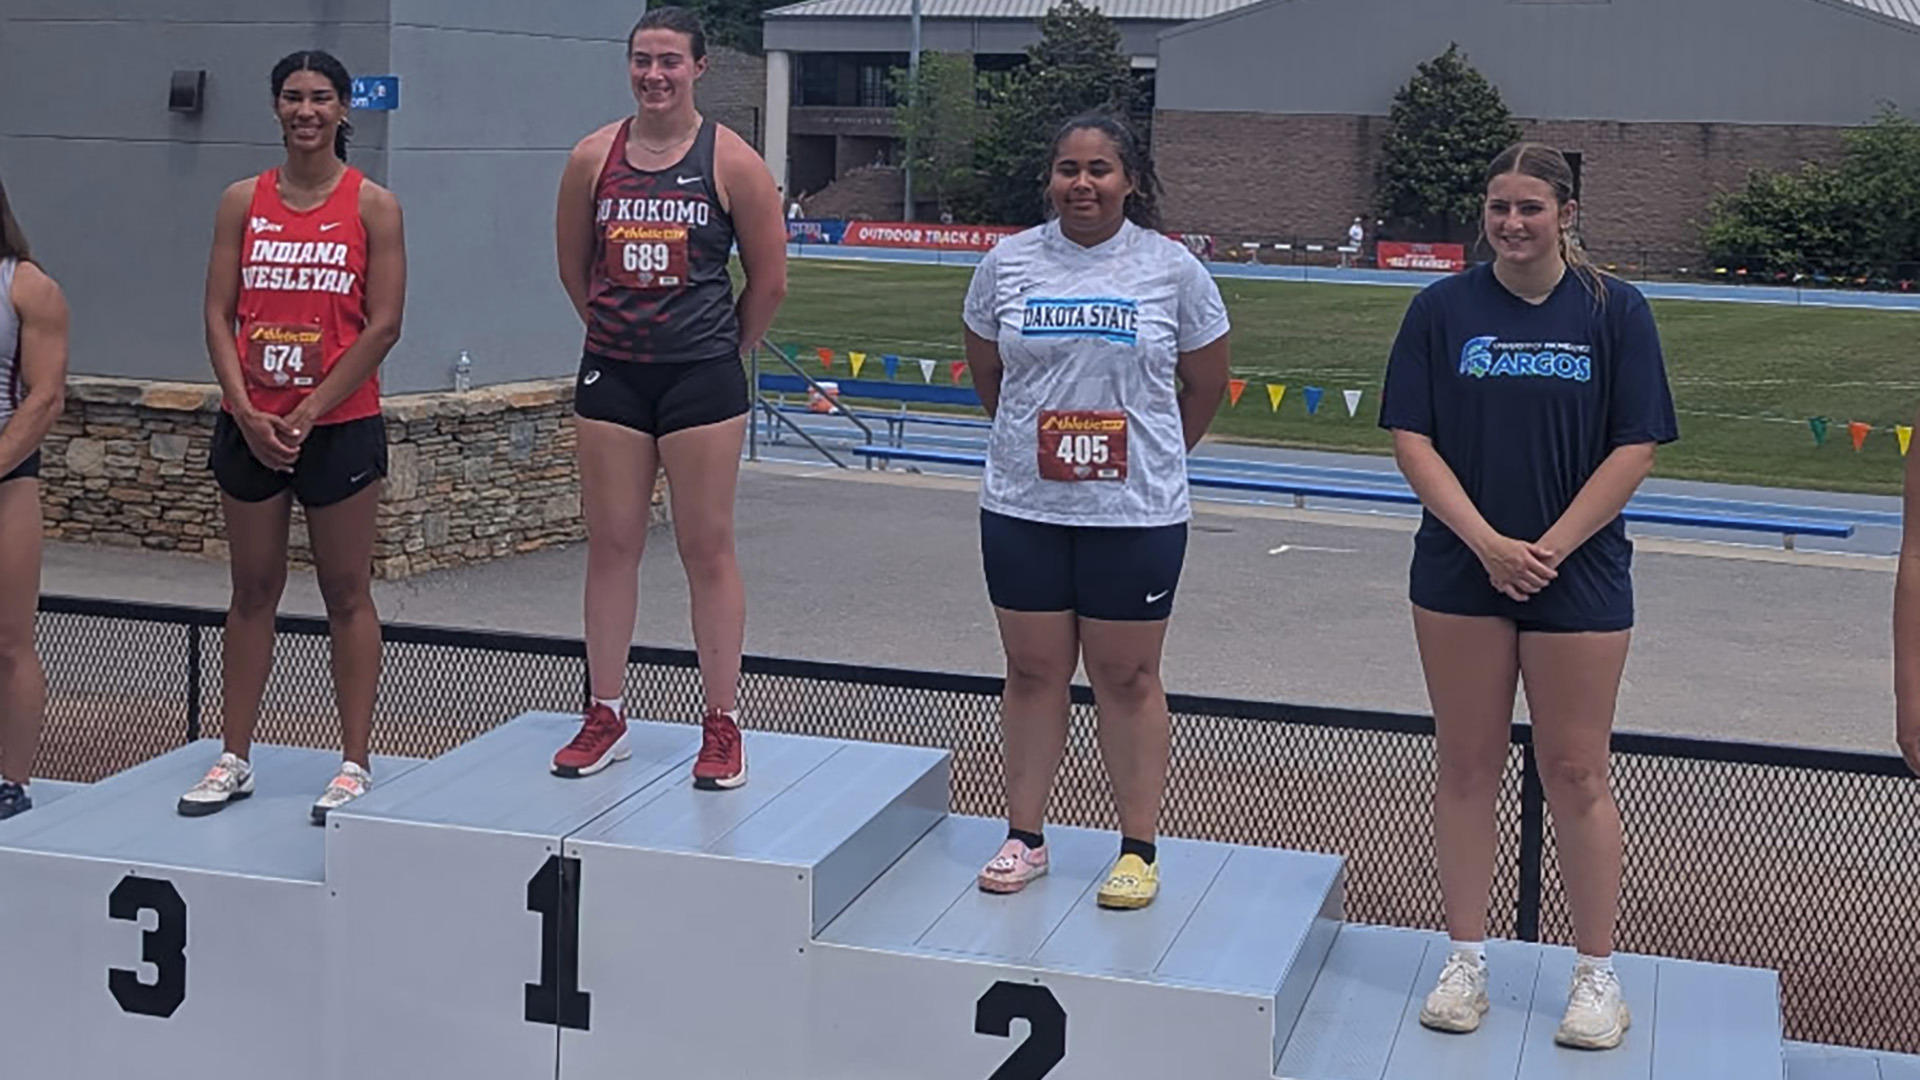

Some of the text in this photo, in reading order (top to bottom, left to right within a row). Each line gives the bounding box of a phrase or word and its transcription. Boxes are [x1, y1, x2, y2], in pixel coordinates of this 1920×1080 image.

[617, 199, 709, 225] KOKOMO
[859, 227, 922, 242] OUTDOOR
[926, 230, 967, 244] TRACK
[250, 240, 348, 267] INDIANA
[623, 243, 669, 271] 689
[242, 265, 356, 295] WESLEYAN
[1023, 306, 1138, 331] DAKOTA STATE
[263, 345, 304, 372] 674
[1489, 351, 1591, 382] ARGOS
[1056, 435, 1109, 465] 405
[108, 875, 187, 1018] 3
[524, 855, 590, 1031] 1
[974, 980, 1068, 1080] 2
